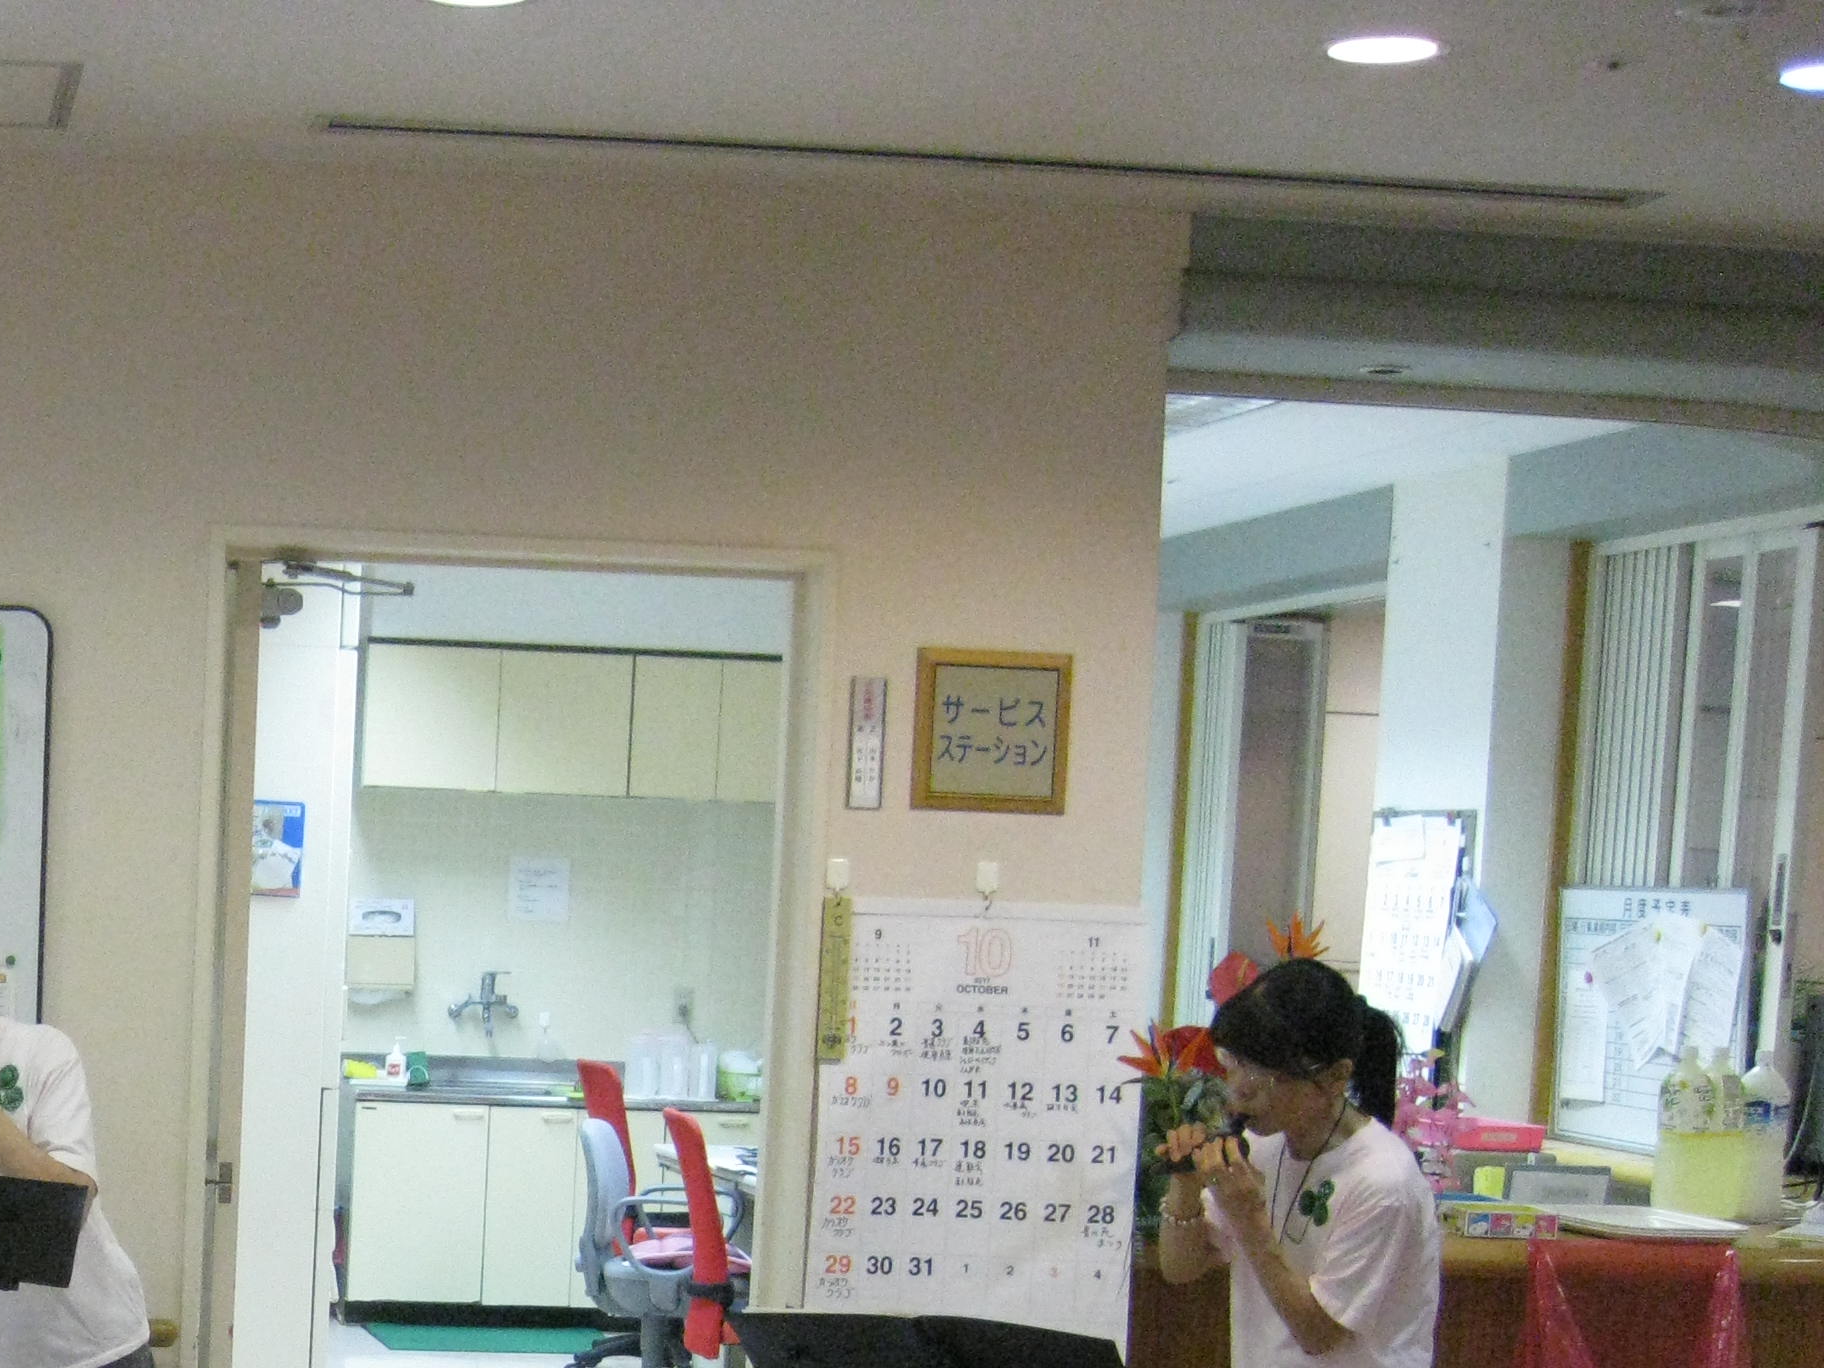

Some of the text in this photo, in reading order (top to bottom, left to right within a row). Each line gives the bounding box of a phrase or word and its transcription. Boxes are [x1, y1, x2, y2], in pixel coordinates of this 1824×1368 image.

[942, 694, 1047, 728] サービス
[937, 735, 1048, 766] ステーション
[874, 927, 1100, 977] 9 10 11
[956, 985, 1009, 995] OCTOBER
[889, 1017, 903, 1036] 2
[931, 1019, 943, 1038] 3
[973, 1020, 986, 1039] 4
[1017, 1022, 1030, 1041] 5
[1061, 1024, 1074, 1043] 6
[1106, 1025, 1120, 1044] 7
[844, 1076, 1122, 1104] 8 9 10 11 12 13 14
[836, 1136, 1116, 1164] 15 16 17 18 19 20 21
[830, 1195, 1115, 1224] 22 23 24 25 26 27 28
[825, 1255, 851, 1274] 29
[866, 1256, 893, 1275] 30
[908, 1257, 933, 1276] 31
[963, 1263, 969, 1273] 1
[1006, 1265, 1015, 1276] 2
[1093, 1269, 1102, 1279] 4
